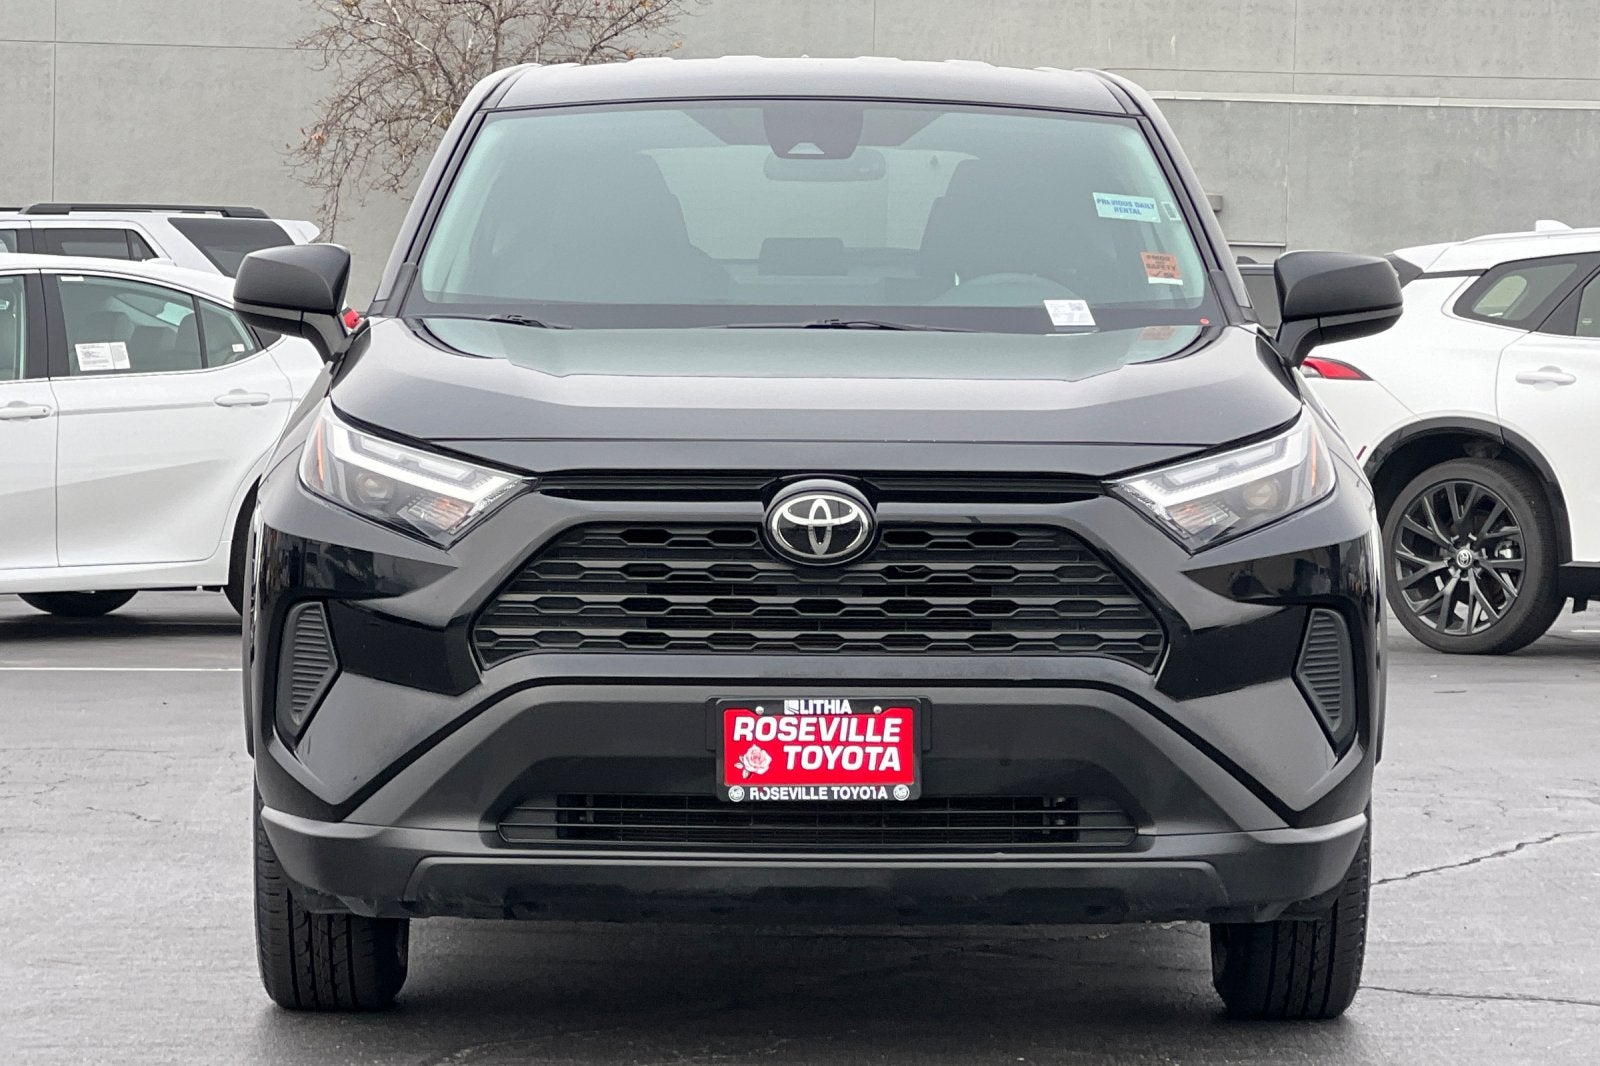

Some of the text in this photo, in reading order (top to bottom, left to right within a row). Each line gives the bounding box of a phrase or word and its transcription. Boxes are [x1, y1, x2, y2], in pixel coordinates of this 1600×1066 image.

[1113, 207, 1142, 215] RENTAL
[1134, 201, 1155, 209] DAILY
[800, 699, 852, 715] LITHIA
[733, 716, 903, 743] ROSEVILLE
[783, 745, 901, 772] TOYOTA
[749, 785, 888, 801] ROSEVILLE TOYOTA
